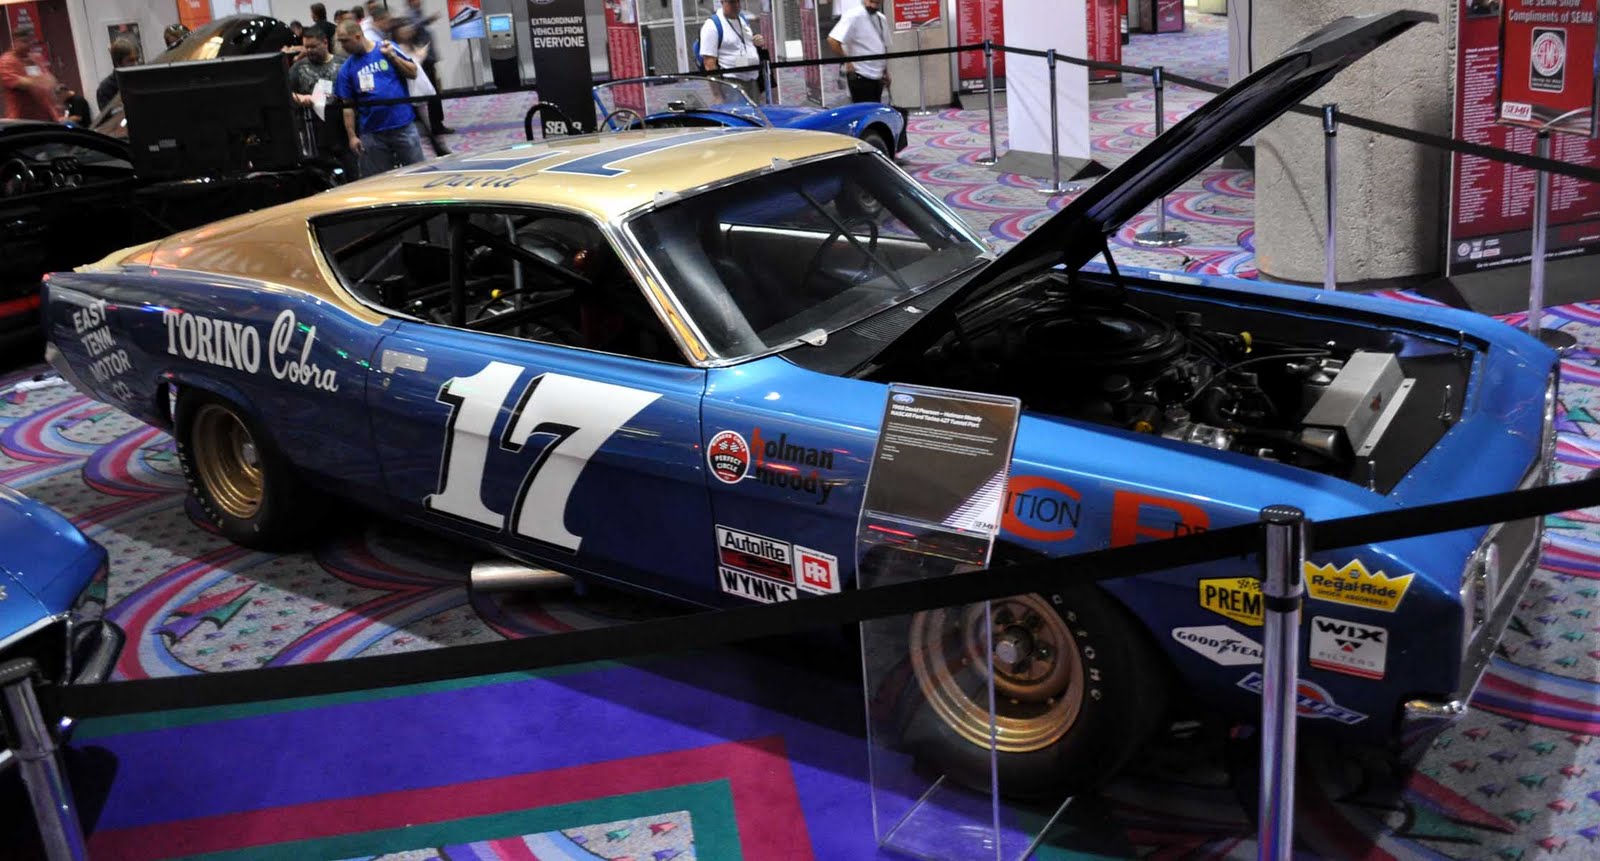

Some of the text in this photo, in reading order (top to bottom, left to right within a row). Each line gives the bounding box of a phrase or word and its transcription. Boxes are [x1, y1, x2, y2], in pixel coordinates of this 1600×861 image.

[531, 16, 583, 26] EXTRAORDINARY
[532, 26, 585, 36] VEHICLES FROM
[1508, 9, 1593, 24] Compliments of SEMA
[533, 36, 586, 48] EVERYONE
[72, 299, 107, 334] EAST
[80, 325, 117, 357] TENN.
[163, 309, 340, 393] TORINO Cobra
[88, 349, 132, 384] MOTOR
[422, 361, 664, 555] 17
[714, 454, 743, 466] PERFECT
[750, 426, 835, 470] holman
[716, 462, 738, 473] CIRCLE
[756, 466, 834, 505] moody
[1004, 492, 1082, 529] ITION
[724, 531, 786, 562] Autolite
[721, 568, 792, 603] WYNN'S
[1205, 585, 1262, 617] PREM
[1176, 630, 1264, 659] GOODYEA
[1315, 620, 1386, 643] WIX
[1318, 650, 1376, 668] FILTERS
